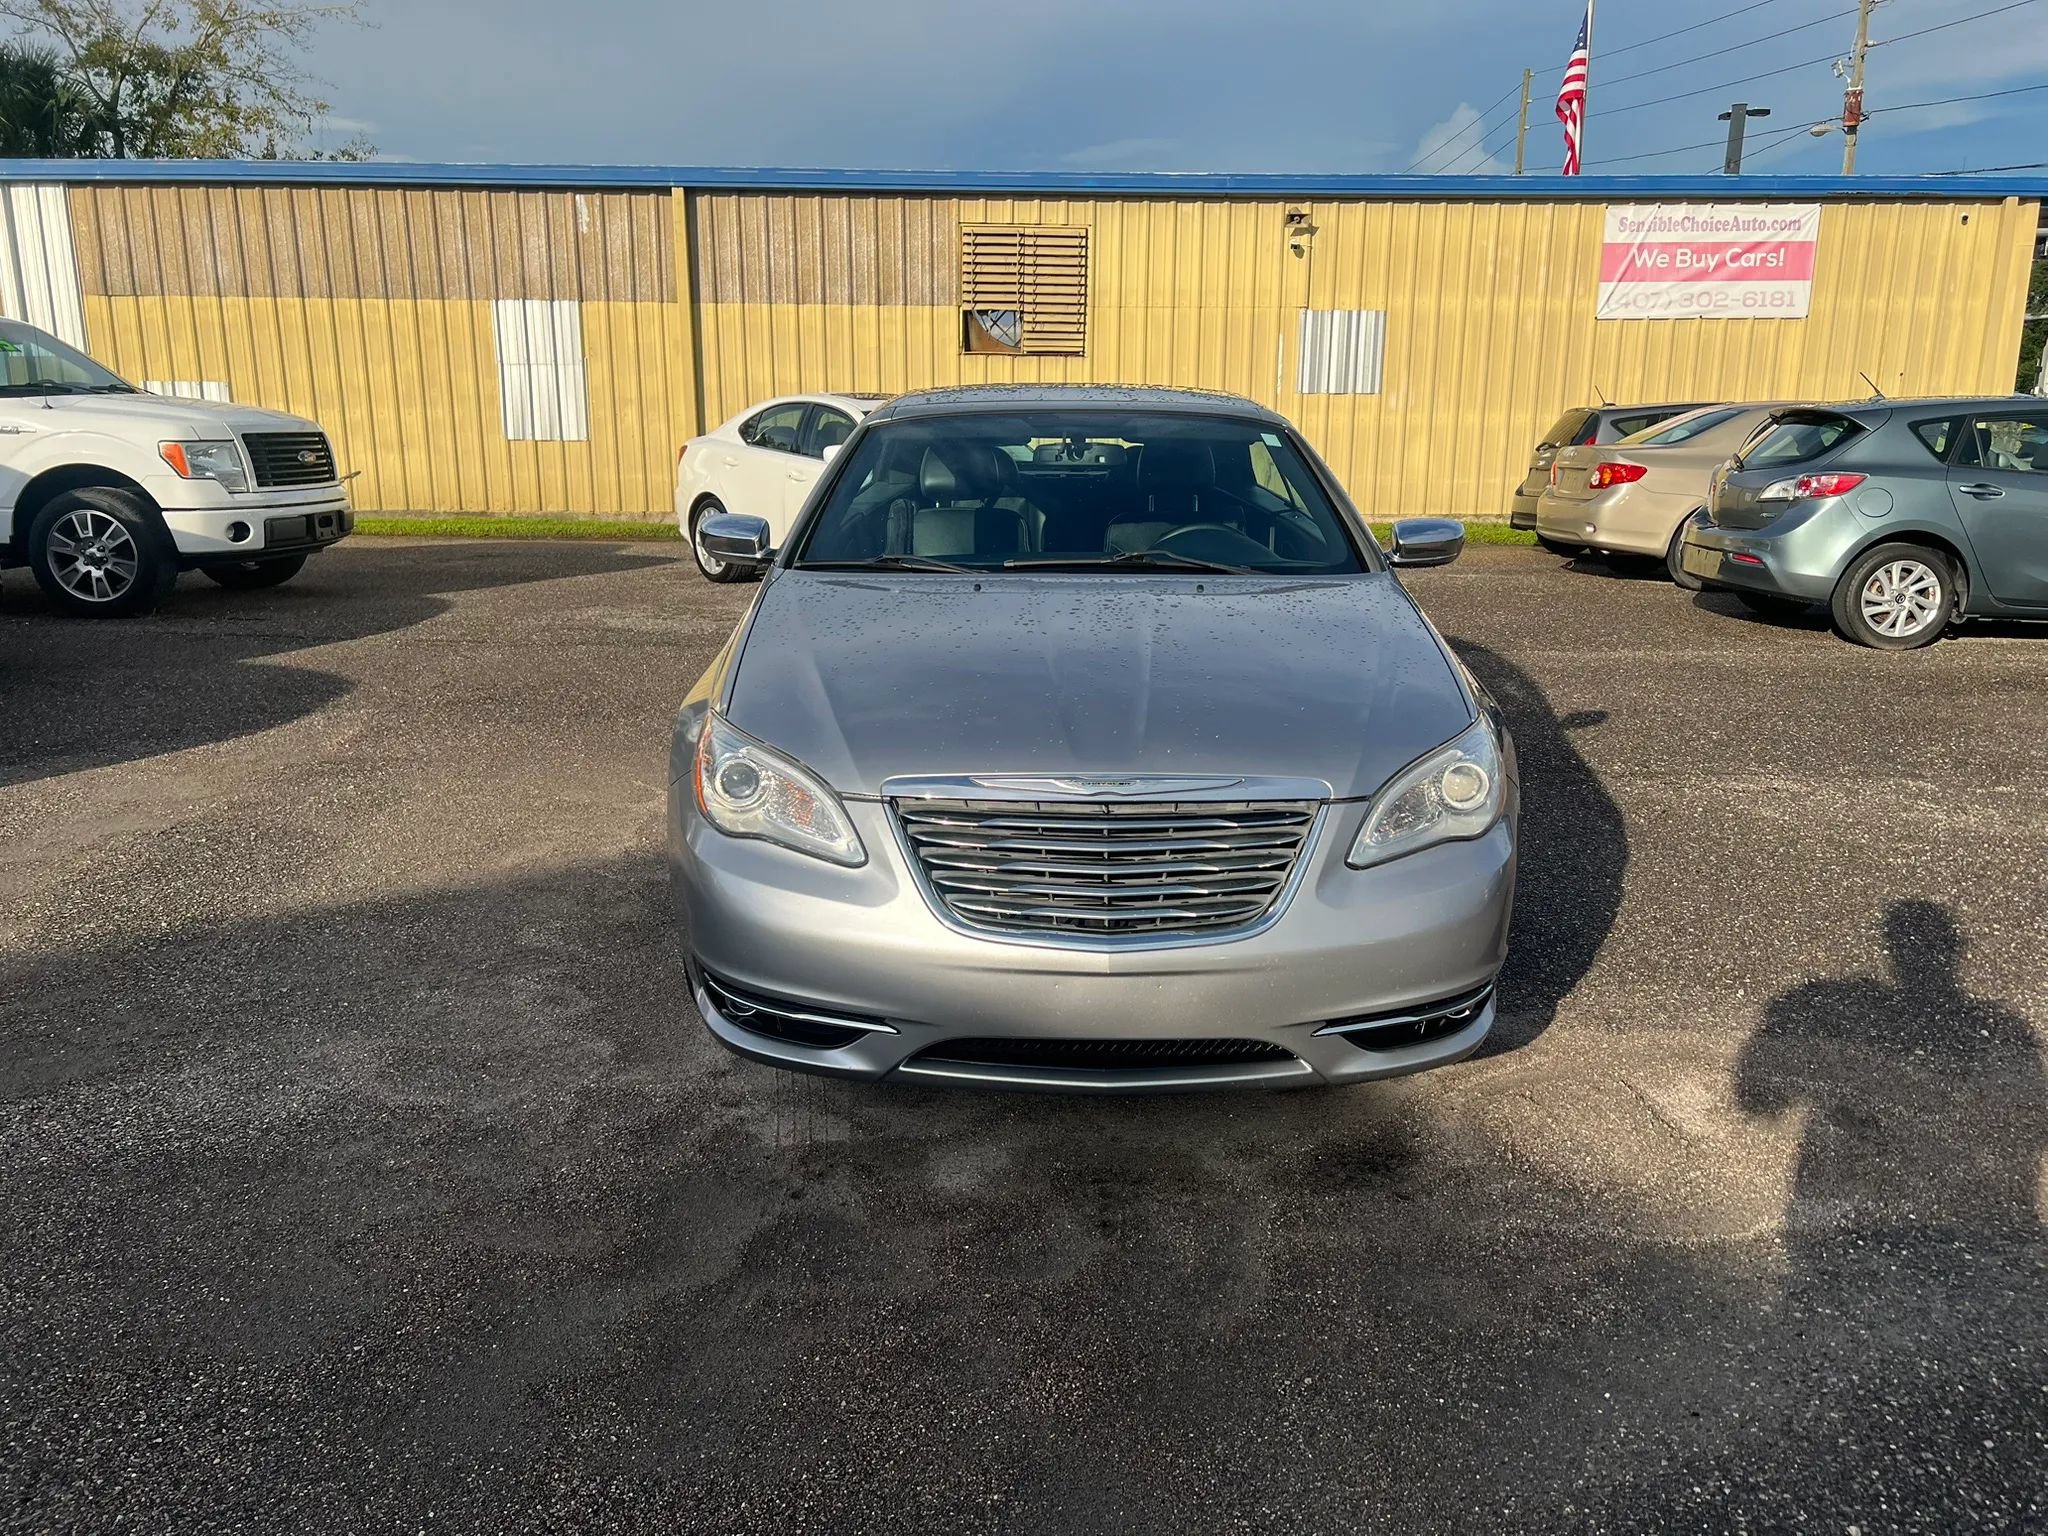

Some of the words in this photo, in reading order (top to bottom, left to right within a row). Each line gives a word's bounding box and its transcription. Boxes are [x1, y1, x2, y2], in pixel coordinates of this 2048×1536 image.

[1633, 248, 1670, 268] We
[1675, 248, 1720, 273] Buy
[1725, 247, 1785, 268] Cars!
[1678, 290, 1796, 309] 302-6181
